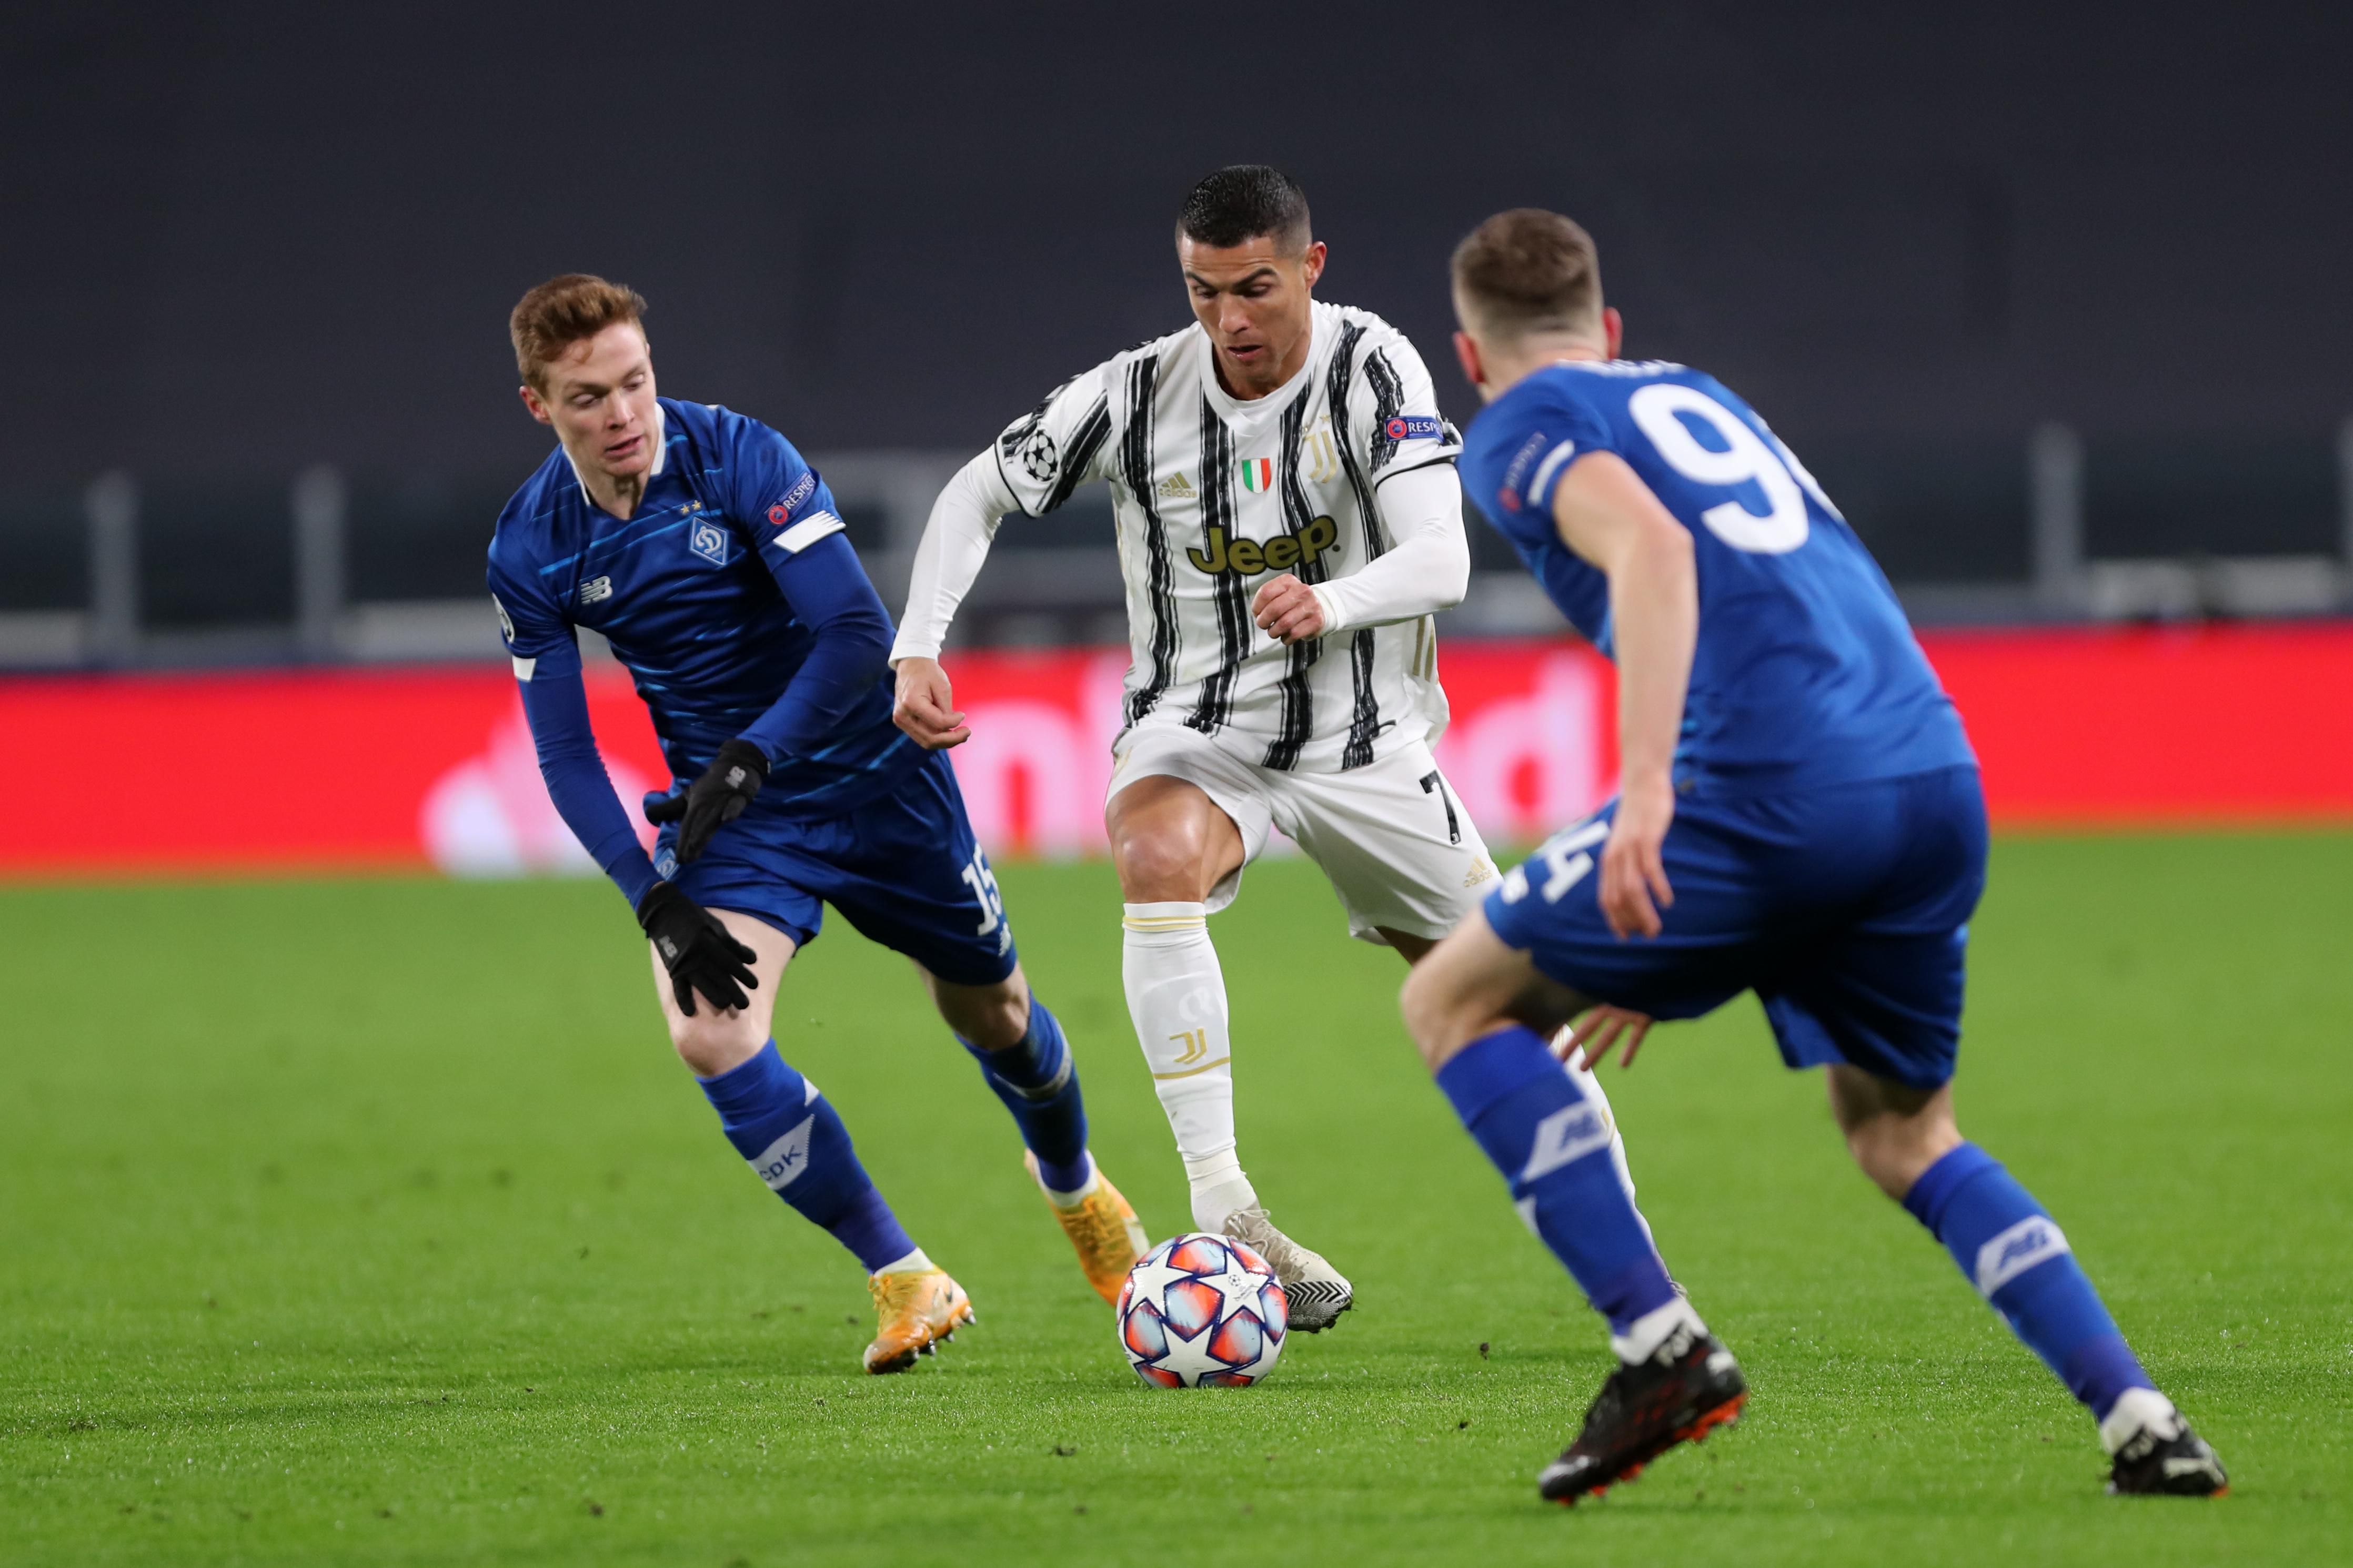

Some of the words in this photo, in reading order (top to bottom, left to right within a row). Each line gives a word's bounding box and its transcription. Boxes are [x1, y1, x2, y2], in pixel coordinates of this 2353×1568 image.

[783, 474, 816, 509] RESPECT
[1419, 769, 1461, 845] 7
[961, 843, 1003, 936] 15
[759, 1145, 803, 1181] CDK
